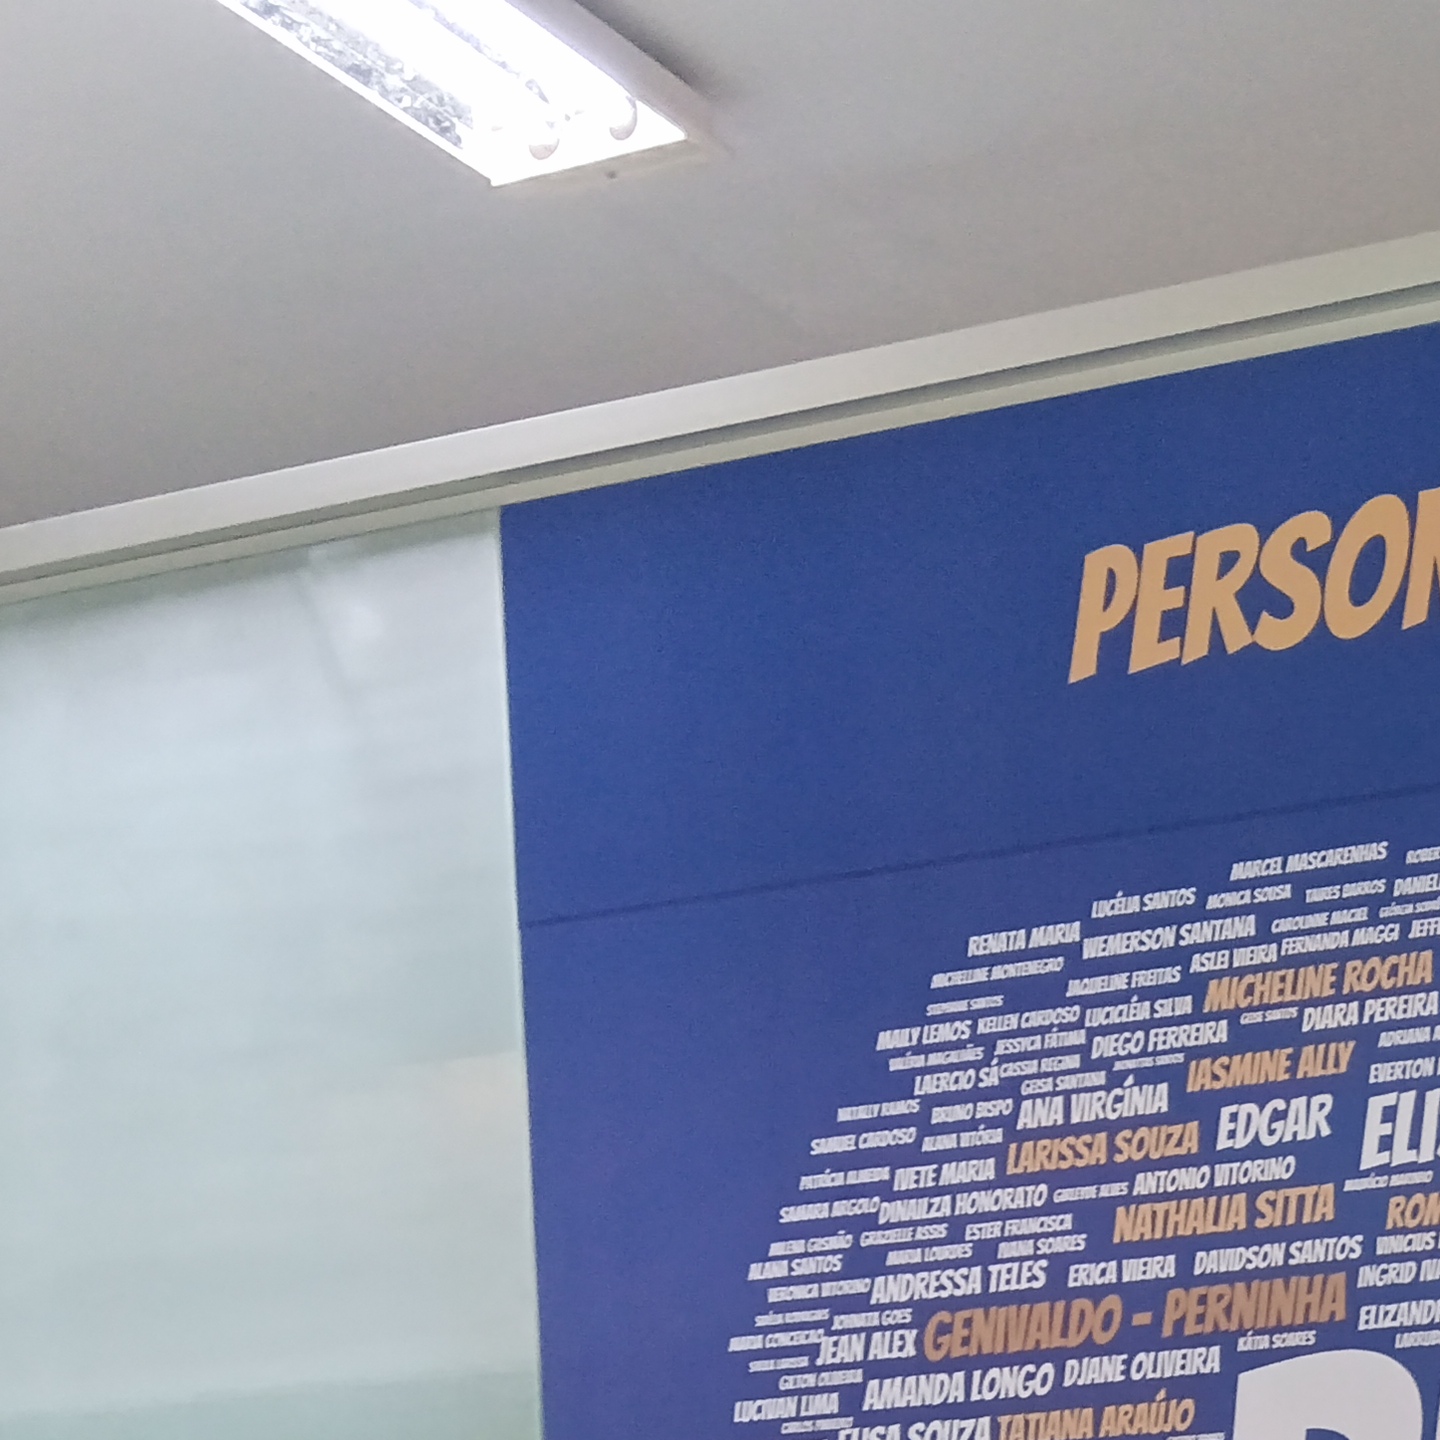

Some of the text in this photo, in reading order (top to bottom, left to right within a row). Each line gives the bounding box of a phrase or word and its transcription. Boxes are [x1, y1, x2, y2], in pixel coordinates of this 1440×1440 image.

[1203, 950, 1432, 1012] MICHELINE ROCHA
[1187, 1048, 1293, 1092] IASMINE
[1296, 1041, 1355, 1079] ALLY
[1017, 1074, 1168, 1130] ANA VIRGÍNIA
[1216, 1094, 1333, 1150] EDGAR
[1007, 1121, 1198, 1175] LARISSA SOUZA
[1113, 1183, 1334, 1243] NATHALIA SITTA
[870, 1259, 1048, 1304] ANDRESSA TELES
[924, 1295, 1122, 1361] GENIVALDO
[1162, 1272, 1346, 1337] PERNINHA
[1099, 1389, 1195, 1437] ARAÚJO
